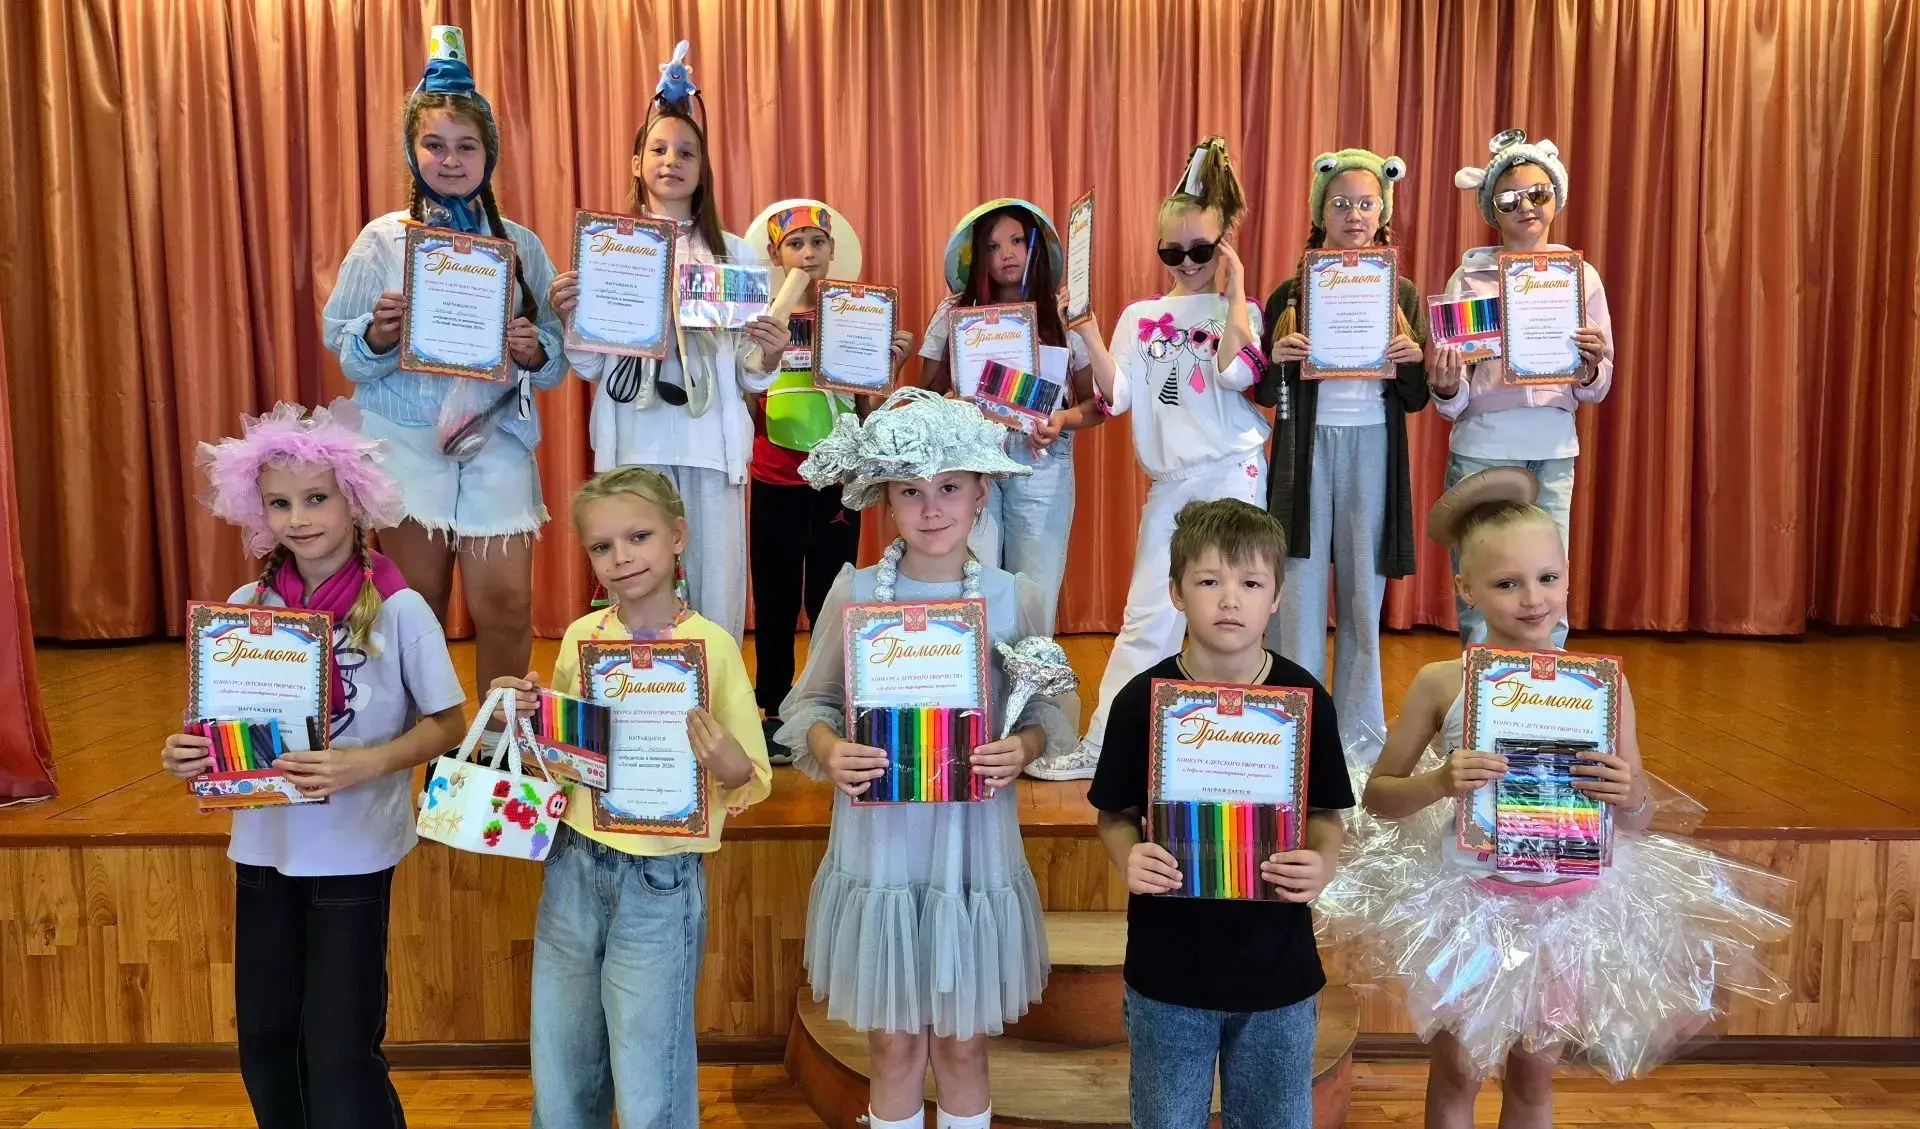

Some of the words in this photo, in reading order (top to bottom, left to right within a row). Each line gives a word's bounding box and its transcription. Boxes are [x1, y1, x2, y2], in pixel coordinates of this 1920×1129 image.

[589, 233, 658, 257] Грамота
[424, 250, 497, 277] Грамота
[1318, 267, 1381, 290] Грамота
[1514, 272, 1570, 295] Грамота
[830, 297, 885, 315] Грамота
[964, 326, 1023, 348] Грамота
[212, 633, 309, 668] Грамота
[870, 632, 963, 668] Грамота
[273, 683, 306, 691] ТВОРЧЕСТВА
[604, 668, 688, 702] Грамота
[1491, 677, 1594, 712] Грамота
[238, 706, 283, 714] НАГРАЖДАЕТСЯ
[1176, 712, 1282, 750] Грамота
[1492, 719, 1524, 728] КОНКУРСА
[1525, 722, 1556, 730] ДЕТСКОГО
[1556, 726, 1593, 735] ТВОРЧЕСТВА
[1241, 762, 1279, 770] ТВОРЧЕСТВА
[1202, 787, 1250, 796] НАГРАЖДАЕТСЯ
